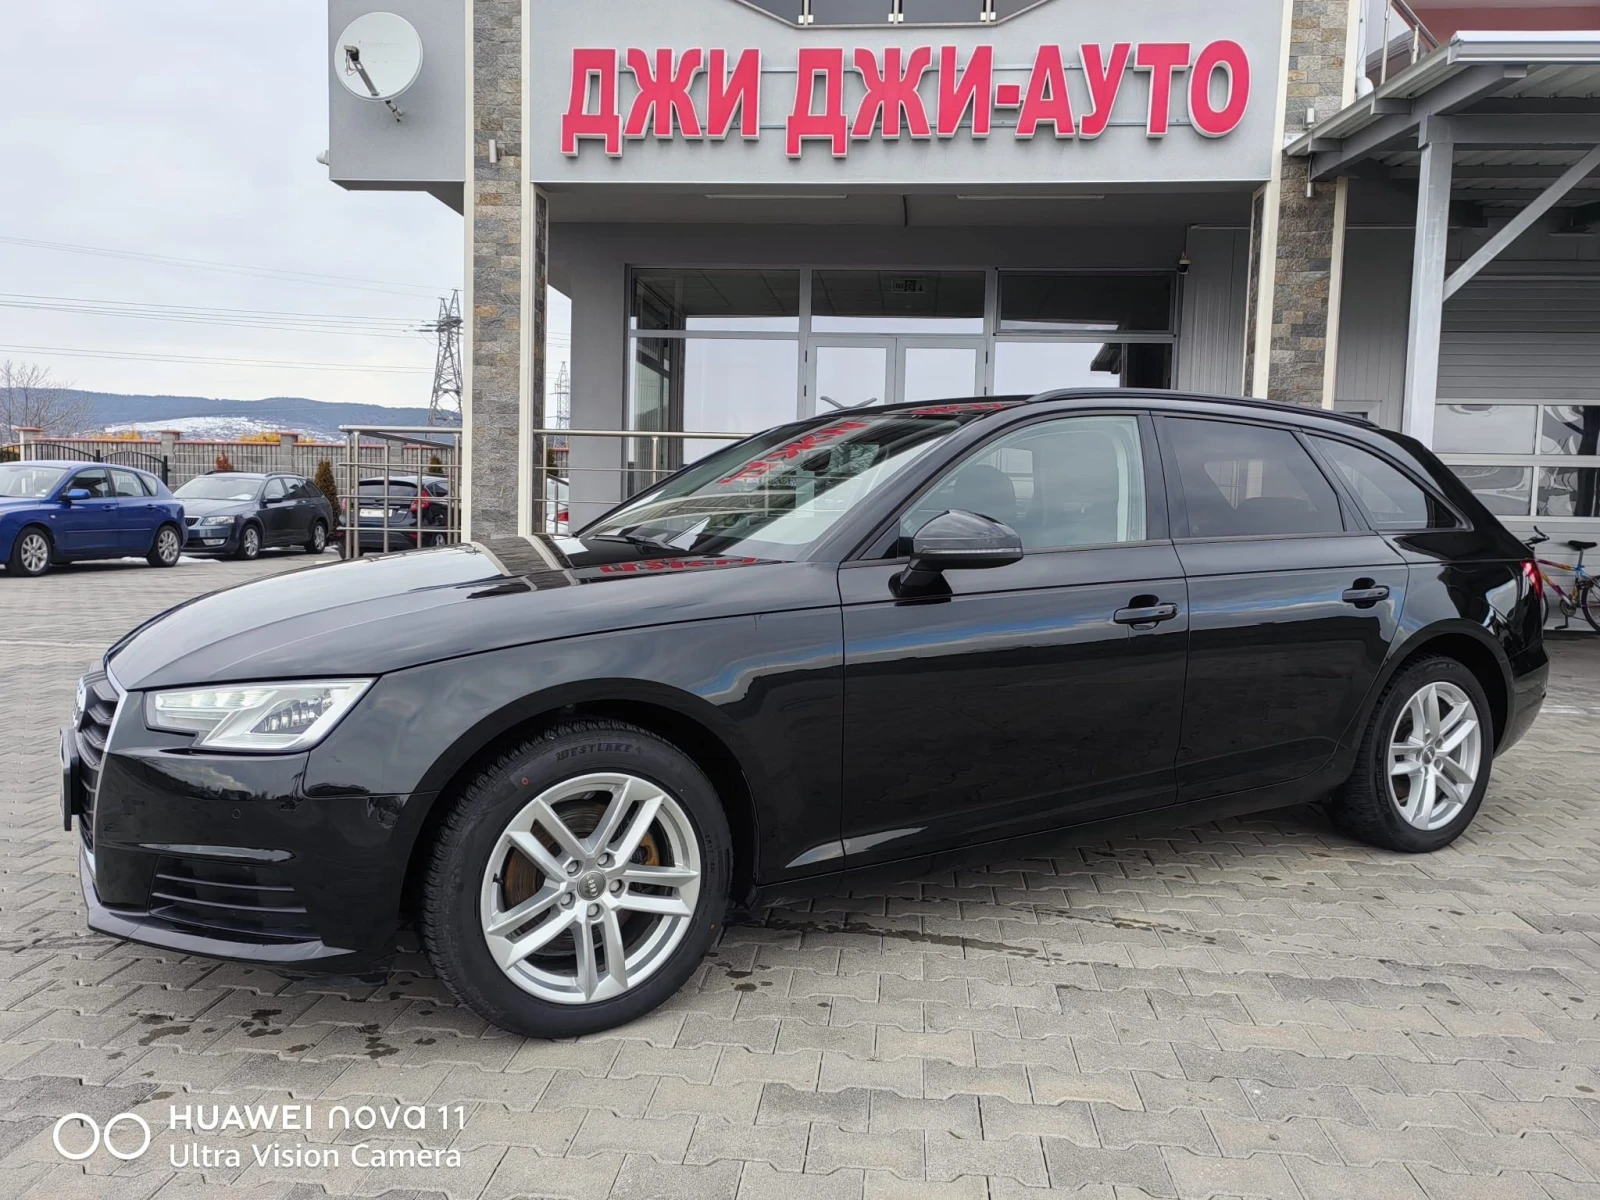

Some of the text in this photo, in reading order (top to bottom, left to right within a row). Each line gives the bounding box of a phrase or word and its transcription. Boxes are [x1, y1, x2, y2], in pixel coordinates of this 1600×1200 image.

[561, 40, 1251, 158] ДЖИ ДЖИ-АУТО
[556, 742, 633, 761] WESTLAKE
